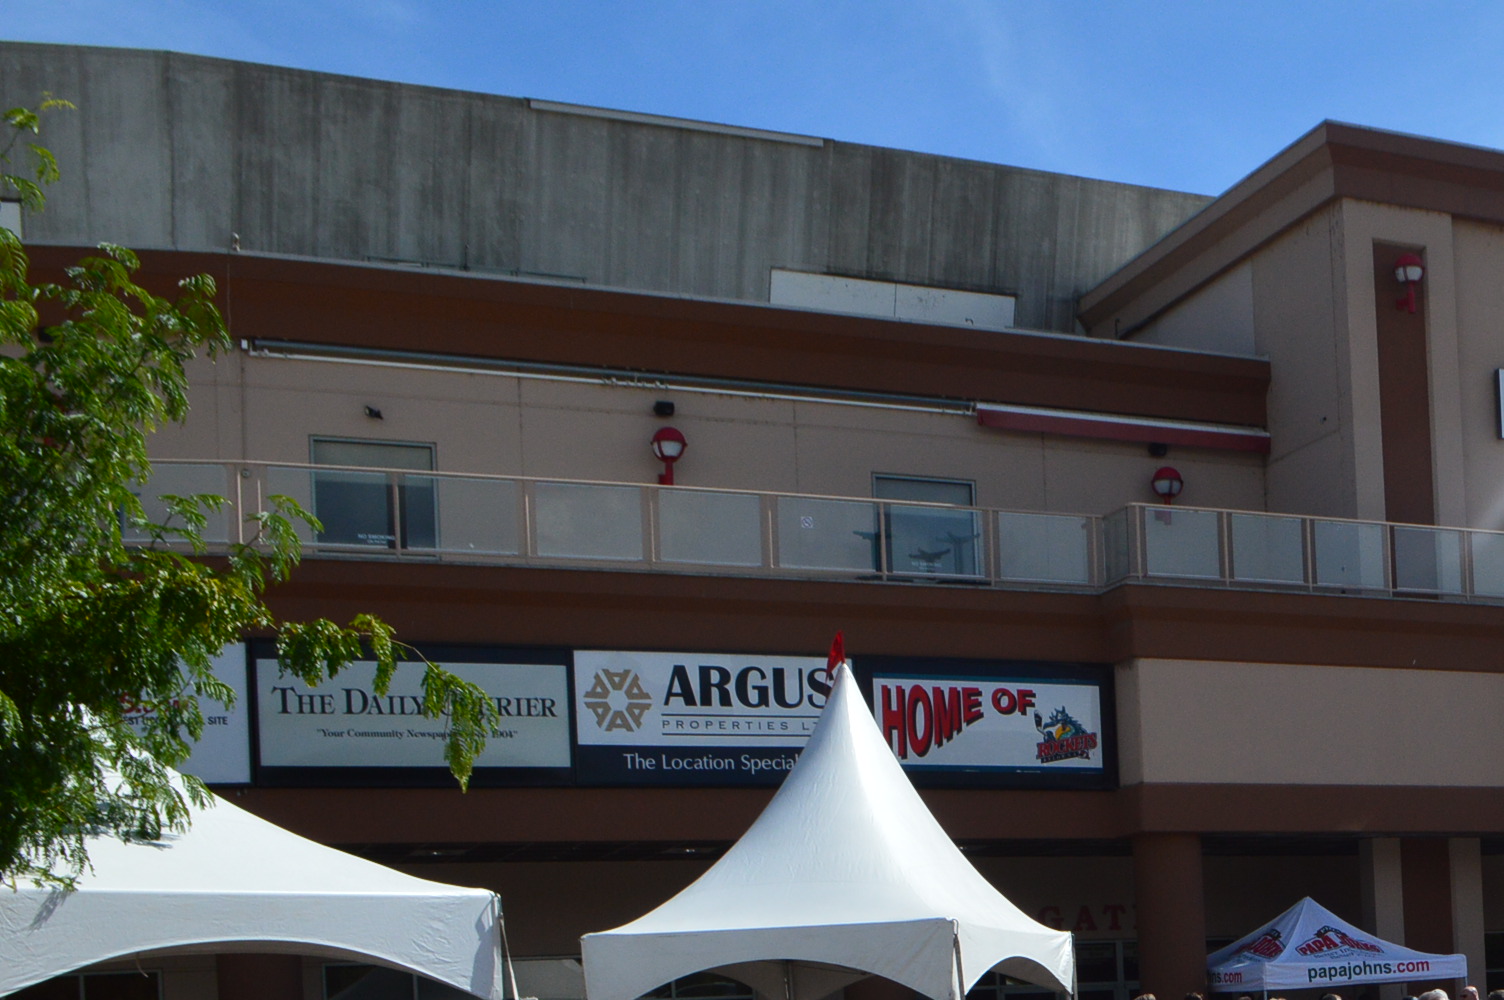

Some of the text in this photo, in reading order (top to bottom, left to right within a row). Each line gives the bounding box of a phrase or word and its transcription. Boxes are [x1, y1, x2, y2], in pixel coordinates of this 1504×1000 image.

[663, 665, 834, 710] ARGUS
[272, 686, 335, 715] THE
[341, 687, 424, 716] DAILY
[207, 716, 229, 726] SITE
[662, 719, 789, 731] PROPERTIES
[880, 684, 1037, 760] HOME OF
[347, 728, 405, 741] Community
[407, 729, 452, 741] Newspap
[1036, 732, 1098, 760] ROCKETS
[623, 753, 800, 775] The Location Special
[1038, 904, 1137, 931] GAT
[1299, 934, 1338, 955] PAPA
[1307, 959, 1430, 982] papajohns.com
